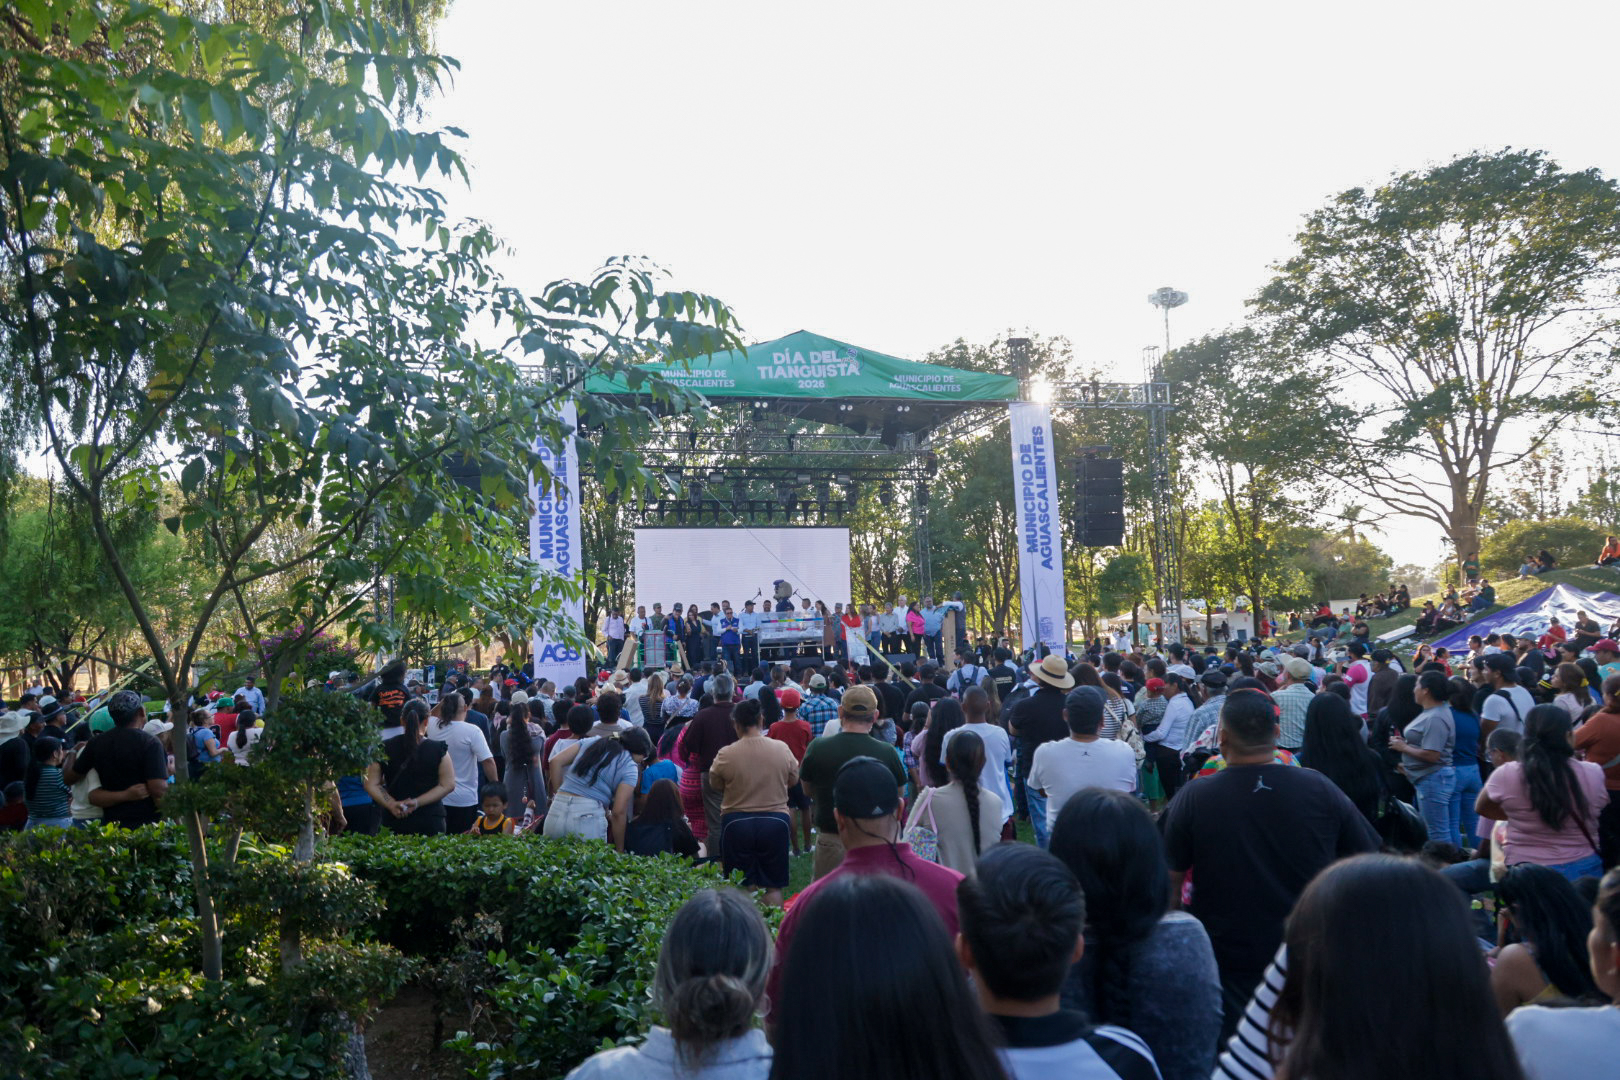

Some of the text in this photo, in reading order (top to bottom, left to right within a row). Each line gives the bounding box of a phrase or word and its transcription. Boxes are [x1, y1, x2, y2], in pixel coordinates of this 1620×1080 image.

[772, 348, 842, 365] DÍA DEL
[714, 369, 727, 378] DE
[757, 363, 860, 379] TIANGUISTA
[943, 375, 955, 383] DE
[798, 379, 825, 389] 2026
[1019, 443, 1039, 553] MUNICIPIO DE
[1032, 425, 1053, 571] AGUASCALIENTES
